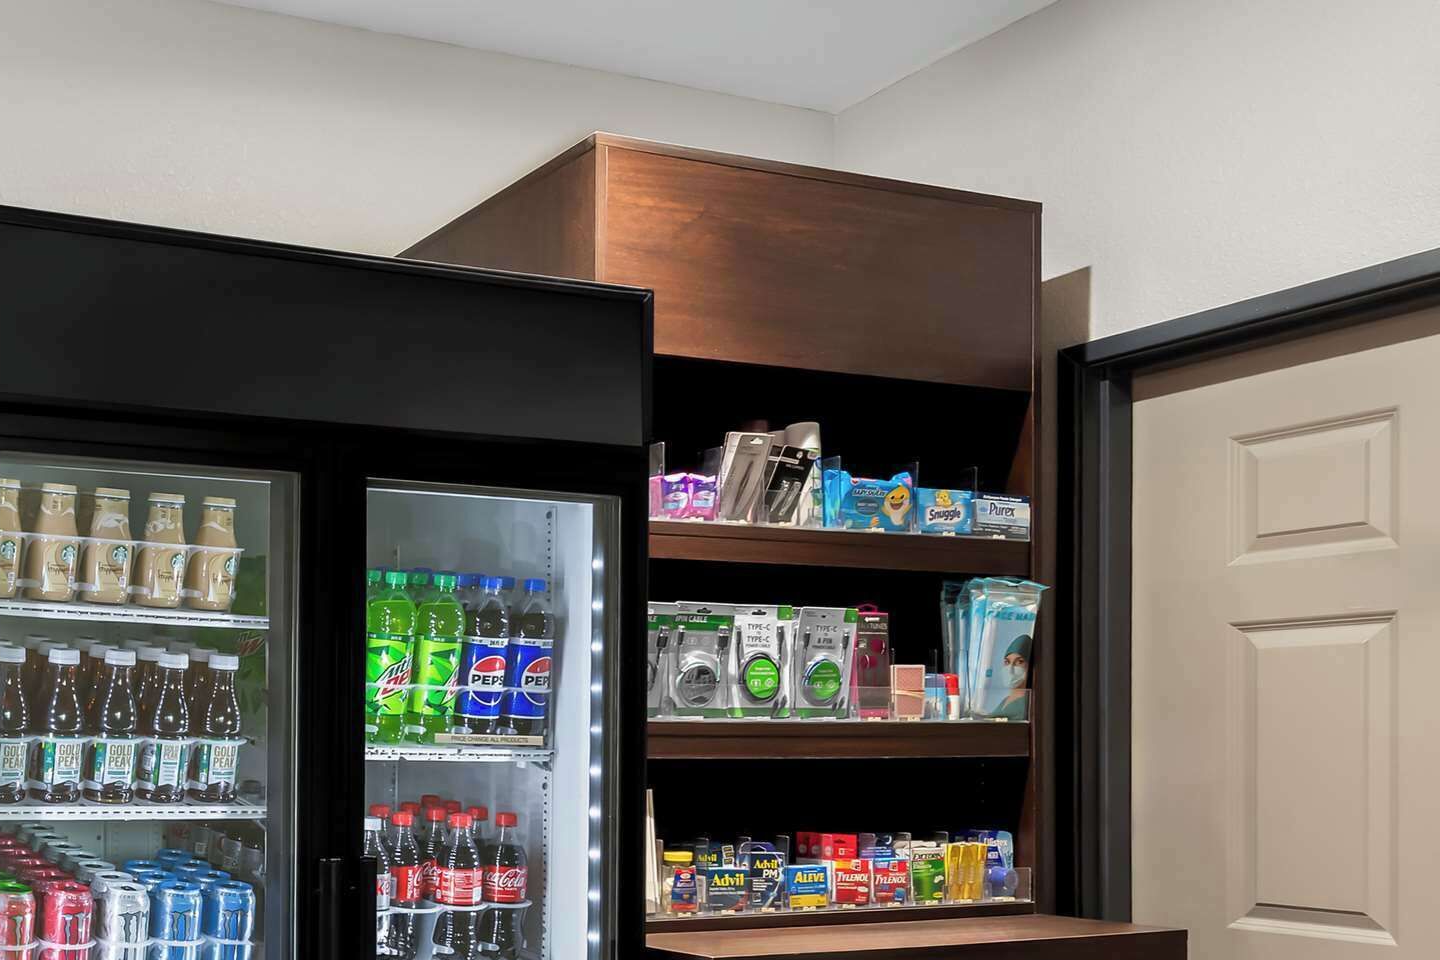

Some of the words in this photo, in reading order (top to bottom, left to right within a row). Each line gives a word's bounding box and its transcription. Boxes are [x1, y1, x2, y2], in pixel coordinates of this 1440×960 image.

[928, 508, 961, 522] Snuggle
[989, 502, 1016, 517] Purex
[746, 635, 770, 643] TYPE-C
[471, 674, 504, 686] PEPS
[525, 675, 550, 686] PEP
[3, 744, 26, 757] GOLD
[58, 743, 81, 756] GOLD
[109, 744, 132, 757] GOLD
[213, 745, 237, 758] GOLD
[57, 755, 80, 768] PEAK
[108, 756, 131, 768] PEAK
[212, 756, 236, 768] PEAK
[698, 854, 718, 862] Advil
[753, 859, 779, 869] Advil
[762, 868, 778, 879] PM
[793, 871, 825, 884] ALEVE
[835, 871, 869, 882] TYLENOL
[874, 874, 907, 885] TYLENOL
[711, 873, 745, 887] Advil
